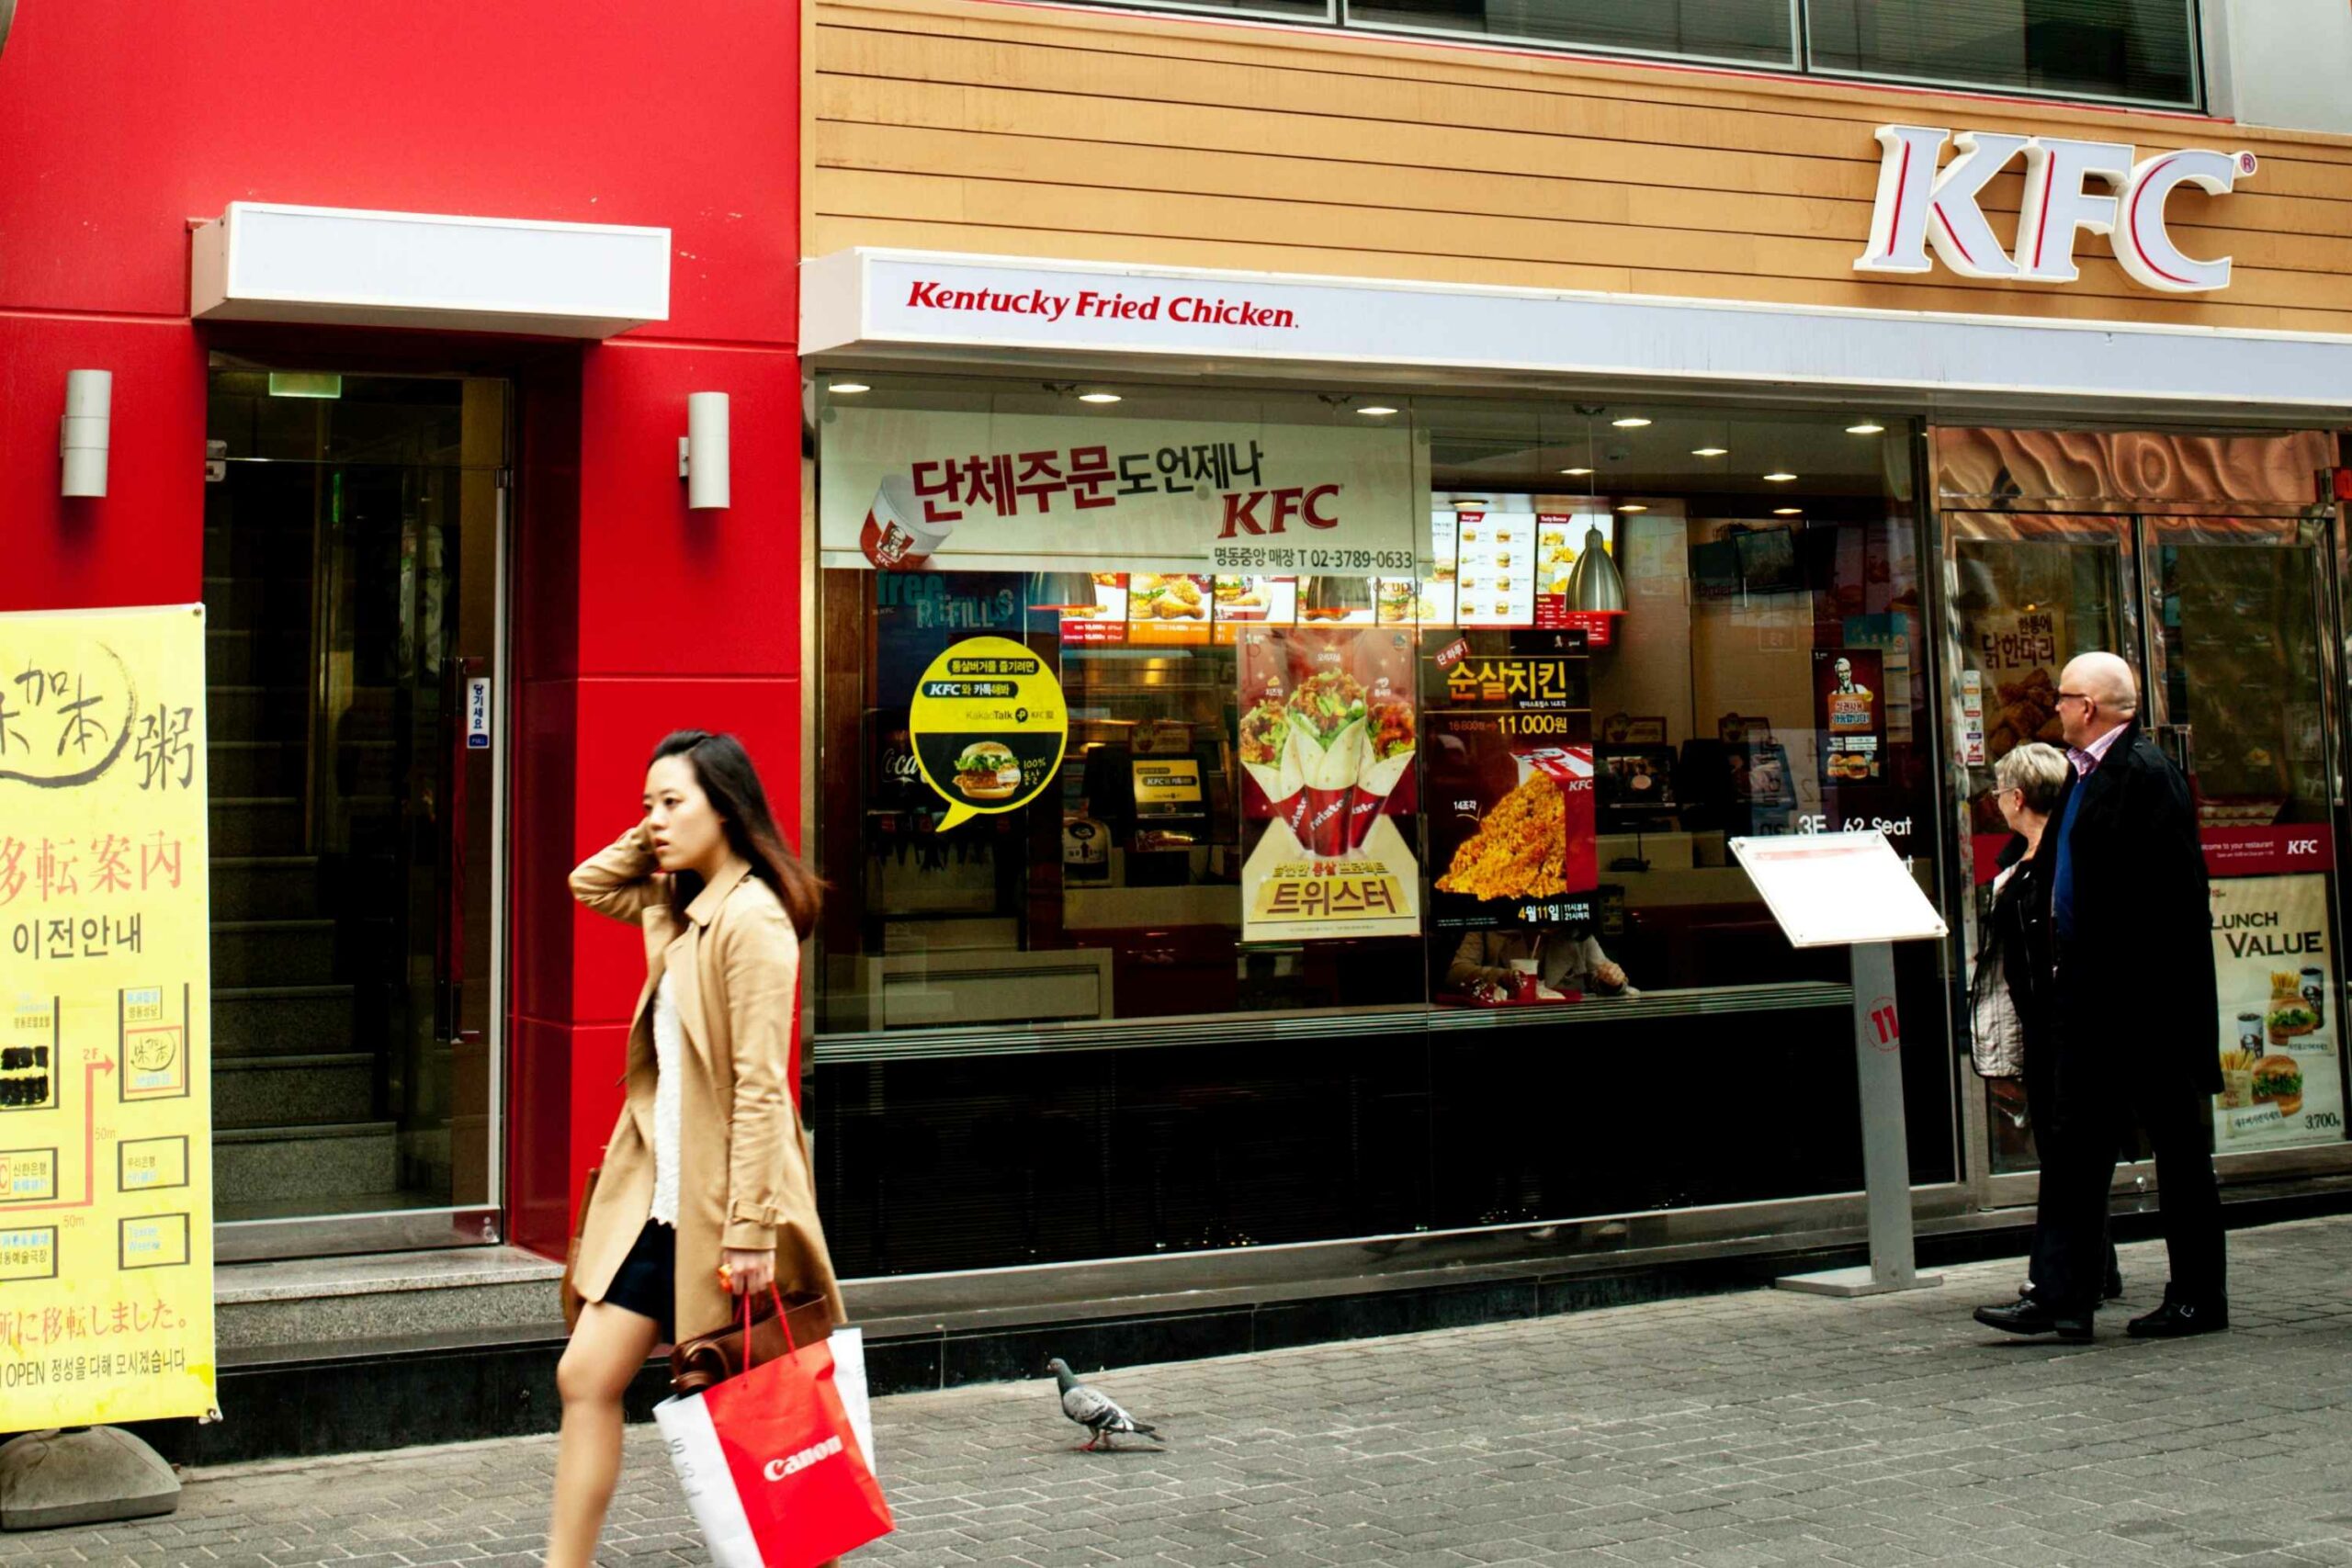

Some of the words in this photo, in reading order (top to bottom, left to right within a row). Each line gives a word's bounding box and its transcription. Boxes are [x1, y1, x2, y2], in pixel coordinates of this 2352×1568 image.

[907, 281, 1070, 321] Kentucky
[1075, 290, 1159, 321] Fried
[1216, 483, 1340, 539] KFC
[1214, 547, 1266, 568] 명동중앙
[1269, 546, 1295, 568] 매장
[1297, 549, 1306, 567] T
[1310, 547, 1413, 569] 02-3789-0633
[1447, 660, 1566, 701] 순살치킨
[134, 703, 195, 792] 粥
[1568, 780, 1594, 793] KFC
[1871, 815, 1913, 836] Seat
[2286, 839, 2318, 855] KFC
[1266, 879, 1396, 916] 트위스터
[13, 912, 141, 961] 이전안내
[2225, 931, 2324, 958] VALUE
[1871, 1004, 1900, 1044] 11
[83, 1048, 99, 1061] 2F
[95, 1126, 116, 1141] 50m
[63, 1215, 85, 1228] 50m
[6, 1360, 45, 1388] OPEN
[51, 1356, 85, 1382] 정성을
[90, 1352, 111, 1380] 다해
[116, 1347, 186, 1375] 모시겠습니다
[763, 1435, 843, 1482] Canon
